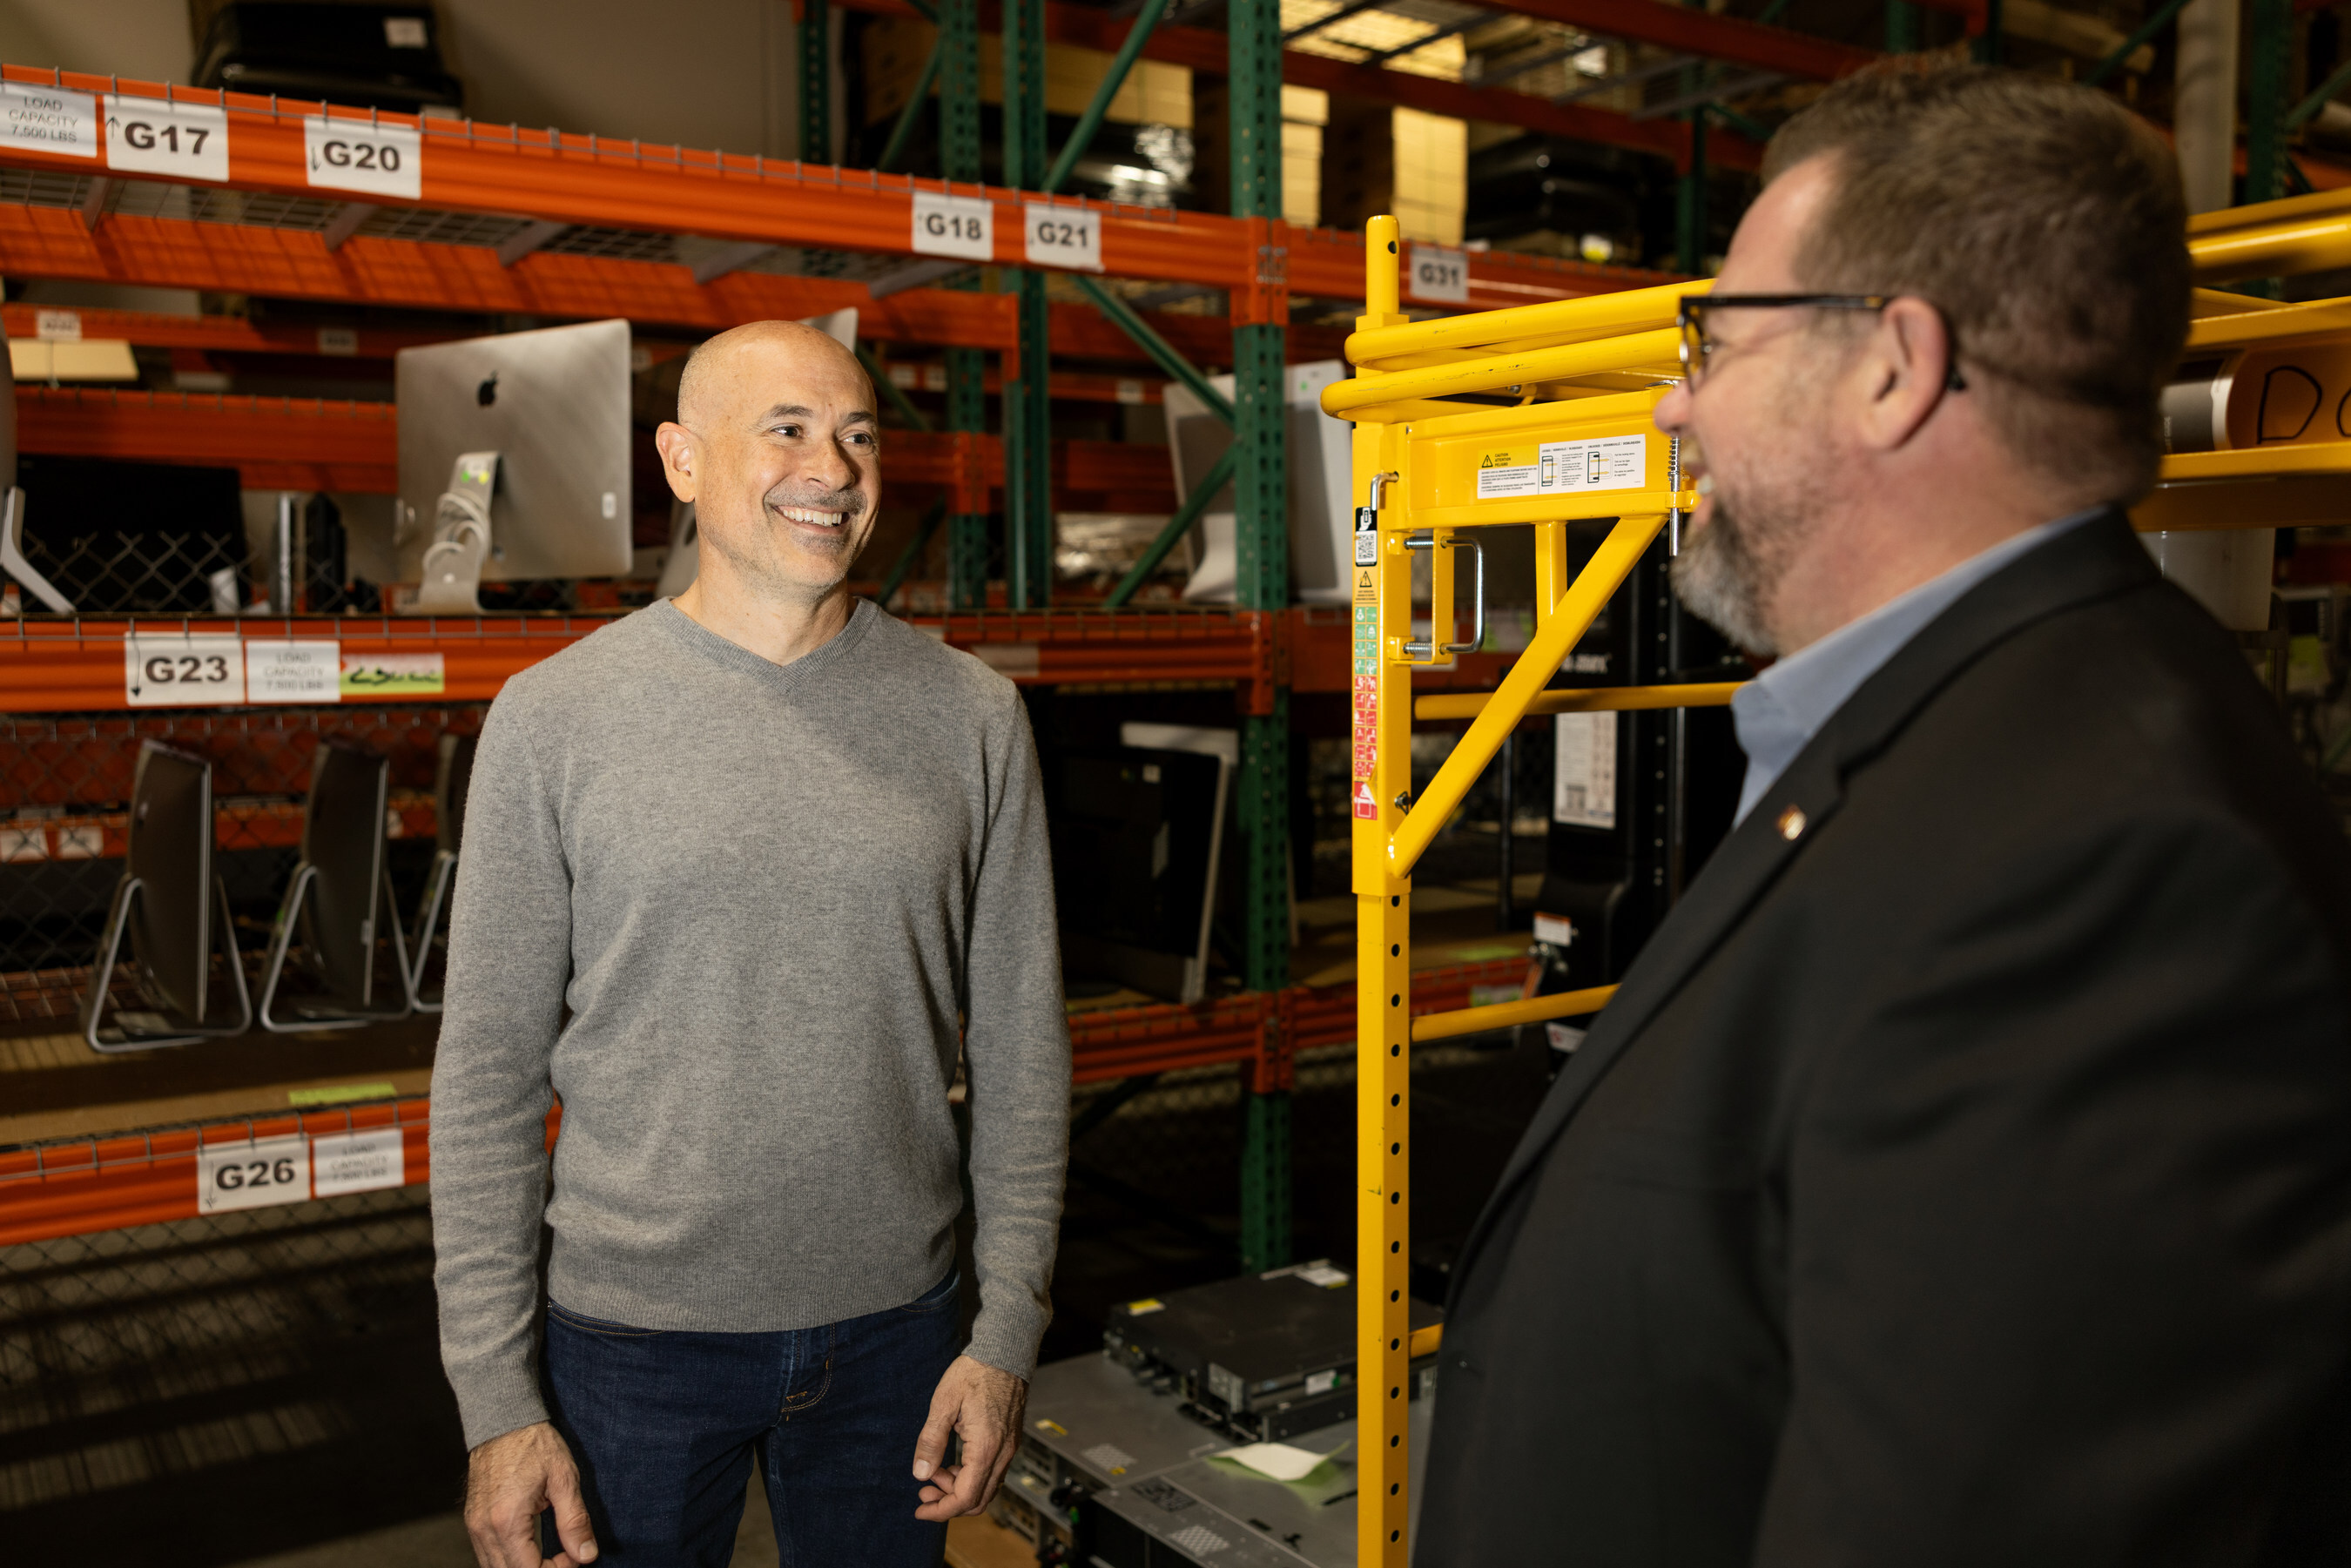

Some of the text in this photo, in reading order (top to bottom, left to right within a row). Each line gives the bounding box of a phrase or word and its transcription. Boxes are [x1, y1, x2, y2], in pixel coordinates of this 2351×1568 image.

[24, 96, 63, 111] LOAD
[9, 109, 78, 127] CAPACITY
[51, 129, 77, 144] LBS
[125, 121, 210, 155] G17
[323, 140, 401, 172] G20
[926, 212, 982, 240] G18
[1038, 221, 1088, 247] G21
[1419, 262, 1459, 287] G31
[145, 655, 229, 683] G23
[215, 1157, 296, 1190] G26
